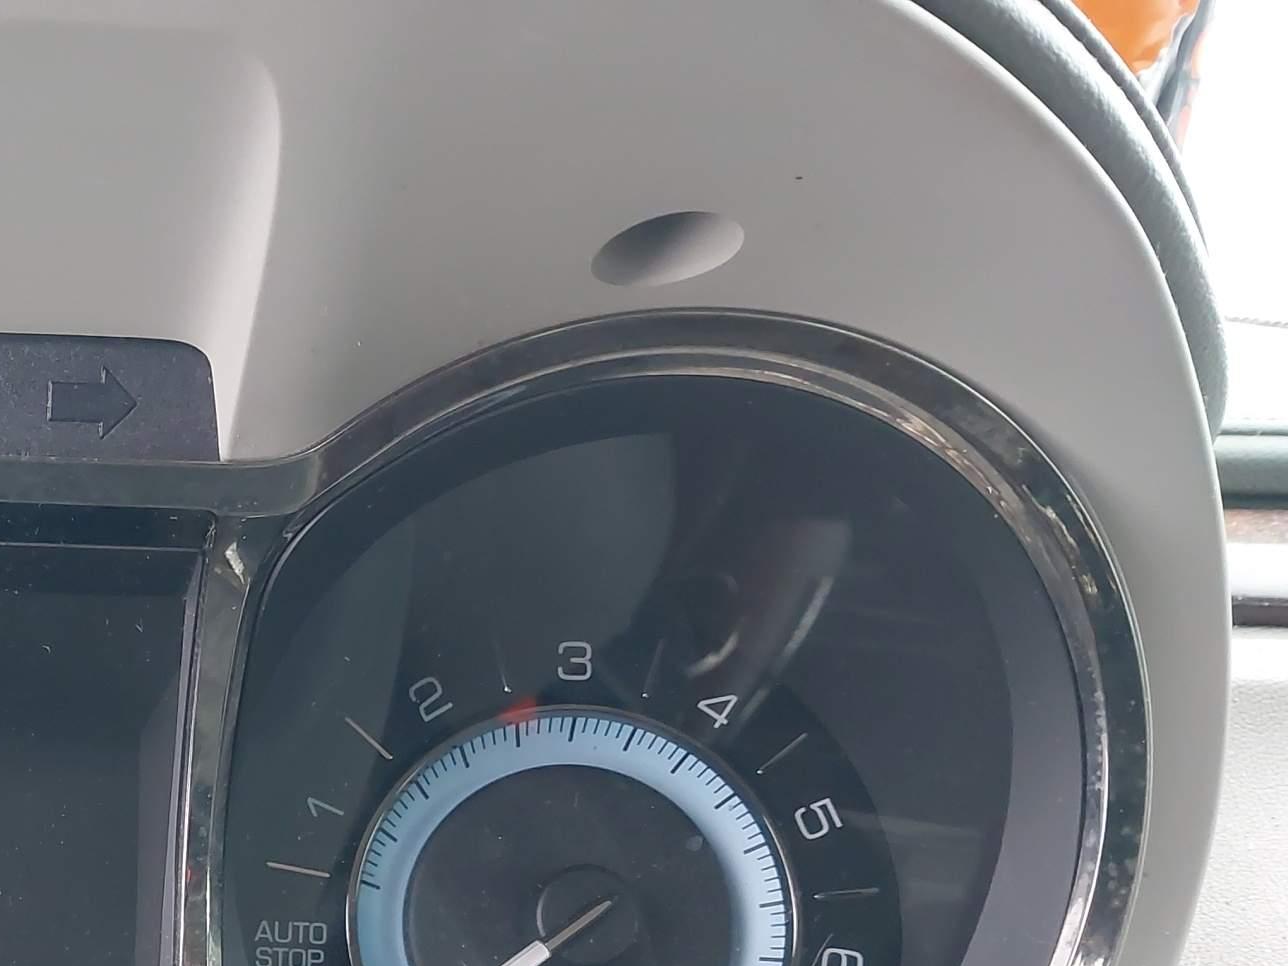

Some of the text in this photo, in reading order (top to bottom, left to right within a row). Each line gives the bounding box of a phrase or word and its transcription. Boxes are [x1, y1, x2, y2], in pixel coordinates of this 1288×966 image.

[557, 640, 594, 682] 3
[408, 675, 454, 722] 2
[696, 693, 738, 729] 4
[305, 795, 345, 817] 1
[794, 797, 843, 841] 5
[254, 920, 328, 947] AUTO
